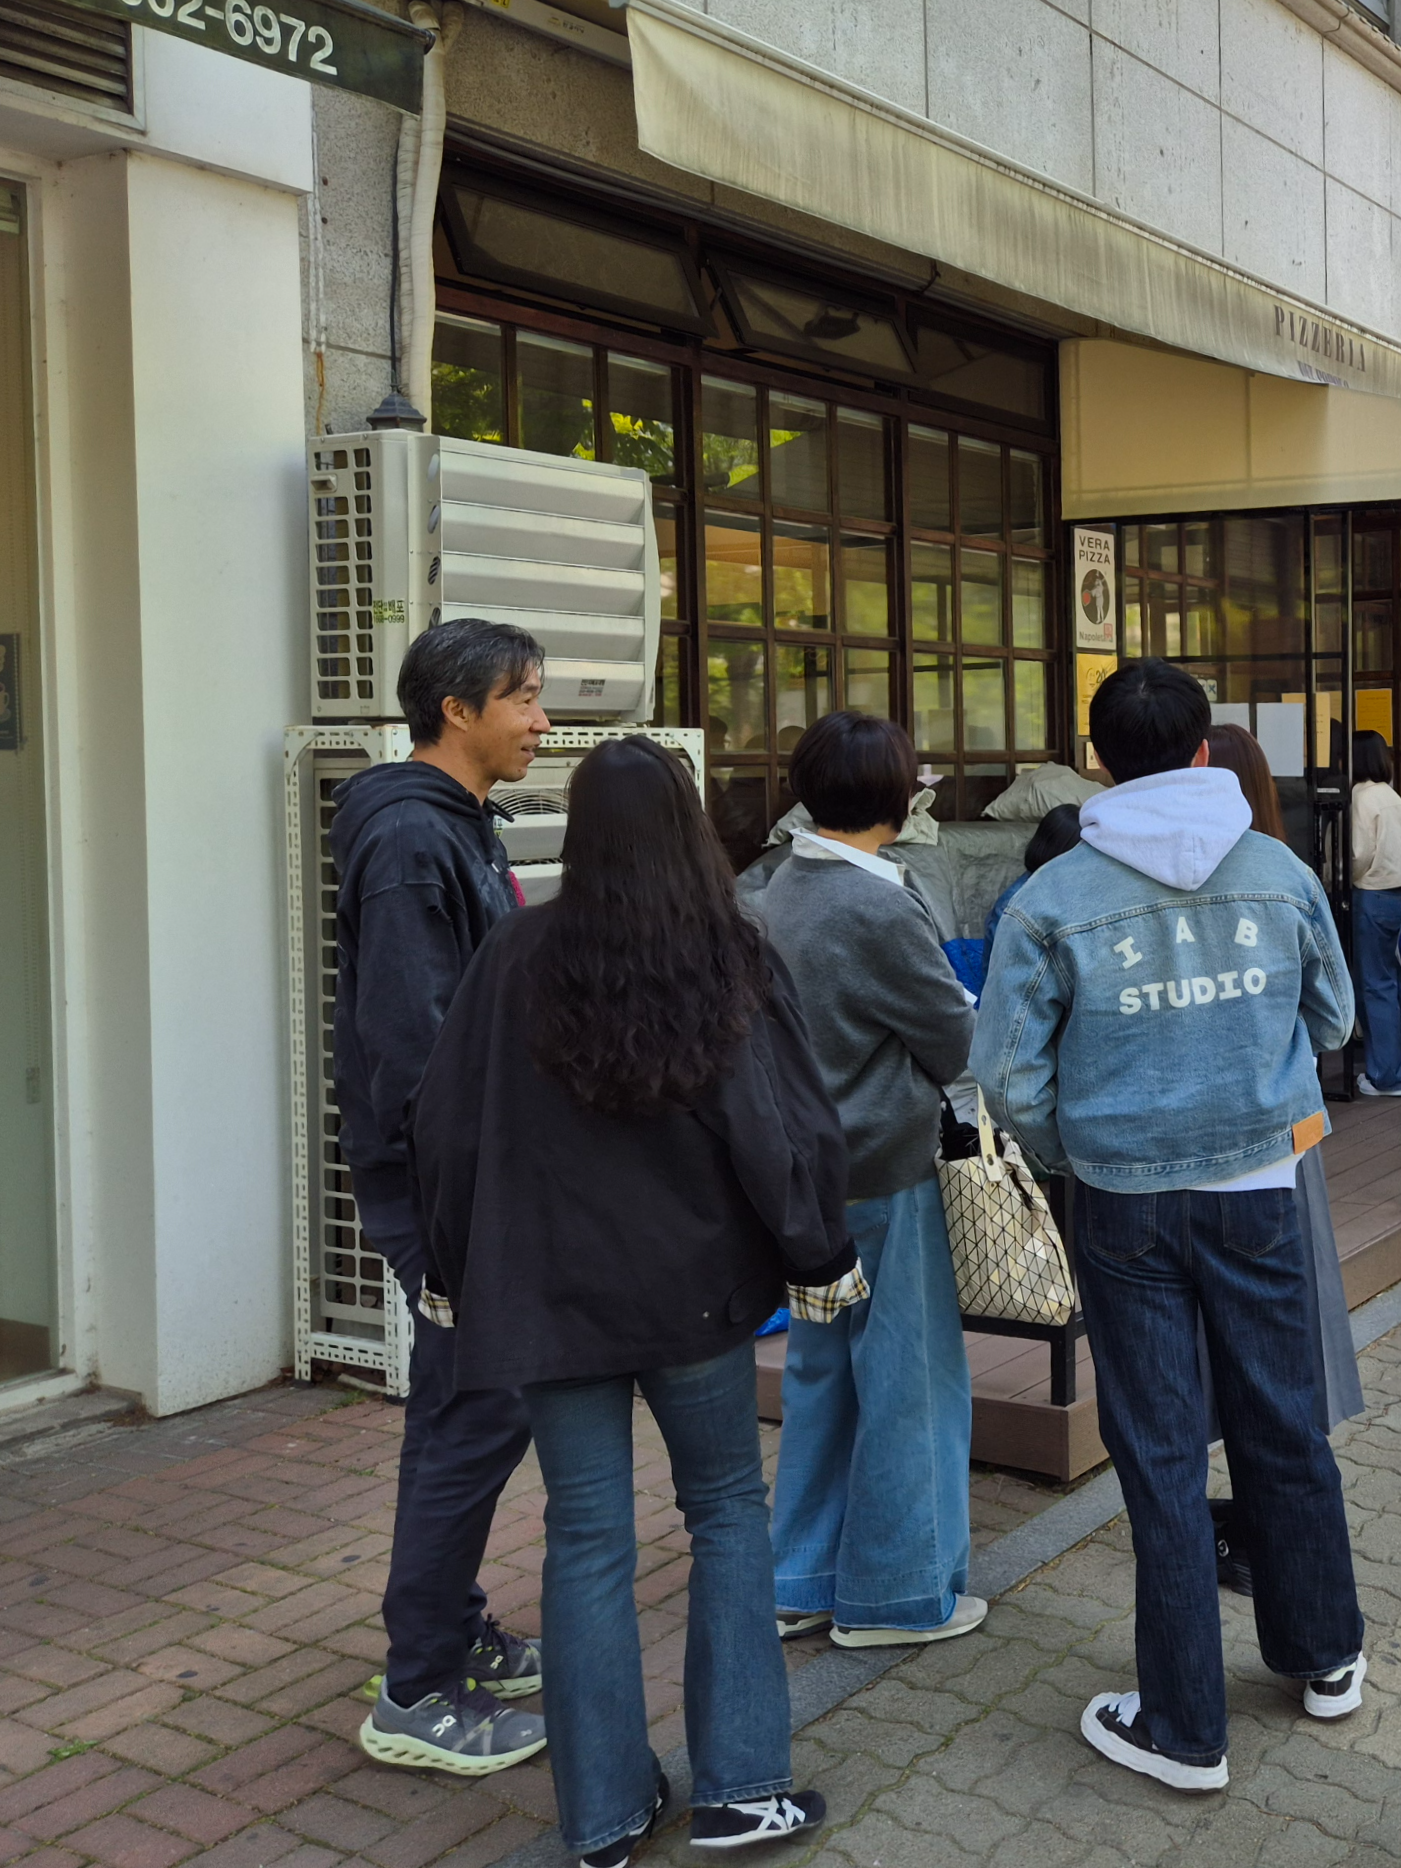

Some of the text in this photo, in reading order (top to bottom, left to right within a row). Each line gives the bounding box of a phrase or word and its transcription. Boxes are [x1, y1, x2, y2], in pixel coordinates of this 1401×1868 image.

[121, 0, 338, 76] 2-6972
[1274, 304, 1366, 373] PIZZERIA
[1079, 535, 1110, 552] VERA
[1079, 550, 1111, 565] PIZZA
[1119, 967, 1267, 1015] STUDIO
